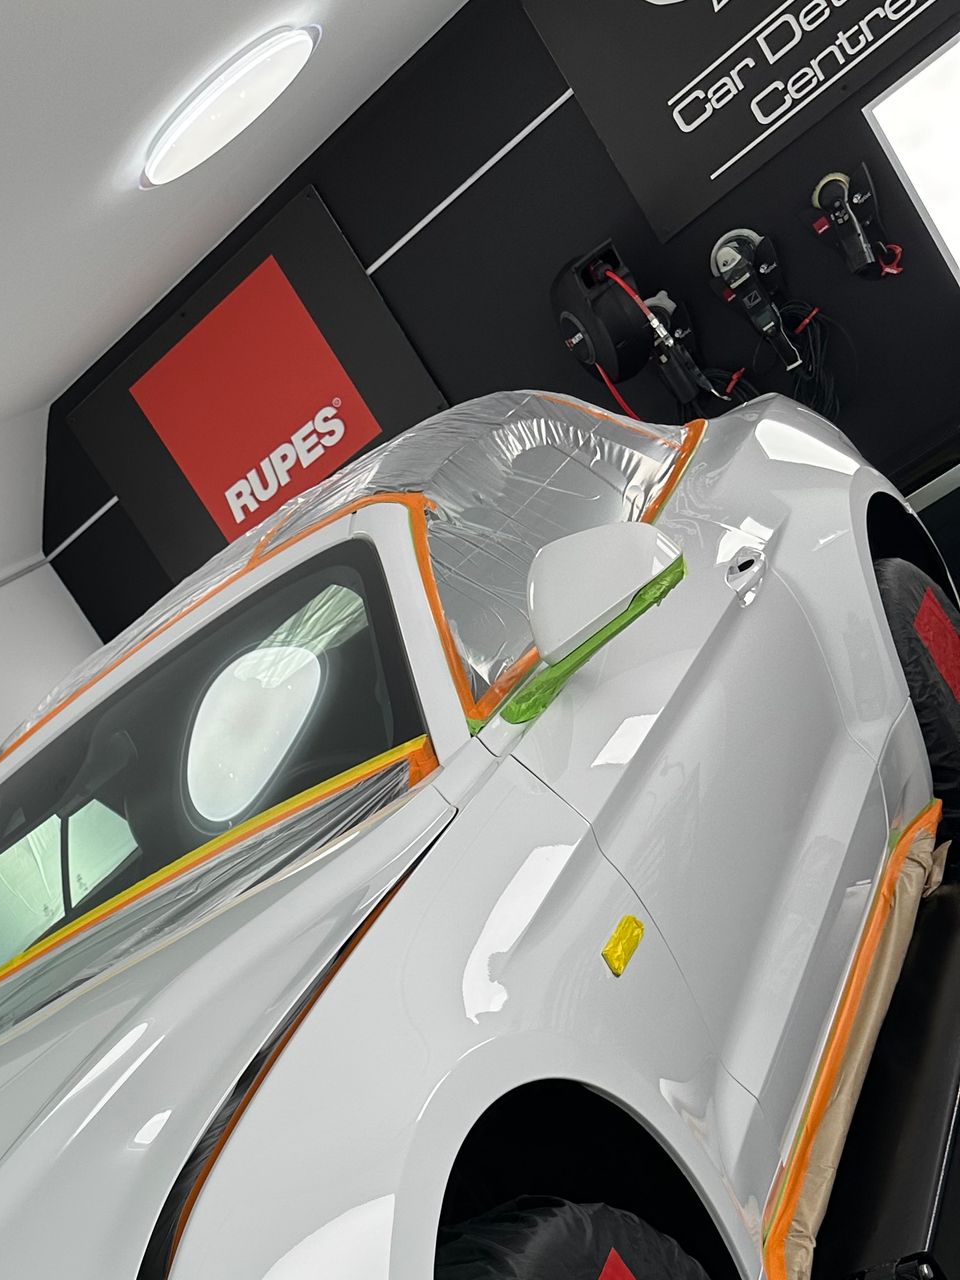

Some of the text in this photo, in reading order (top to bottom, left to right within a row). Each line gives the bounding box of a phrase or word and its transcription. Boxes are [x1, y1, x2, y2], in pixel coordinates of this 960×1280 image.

[673, 0, 847, 133] Car De
[750, 0, 918, 125] Centre
[224, 406, 346, 524] RUPES
